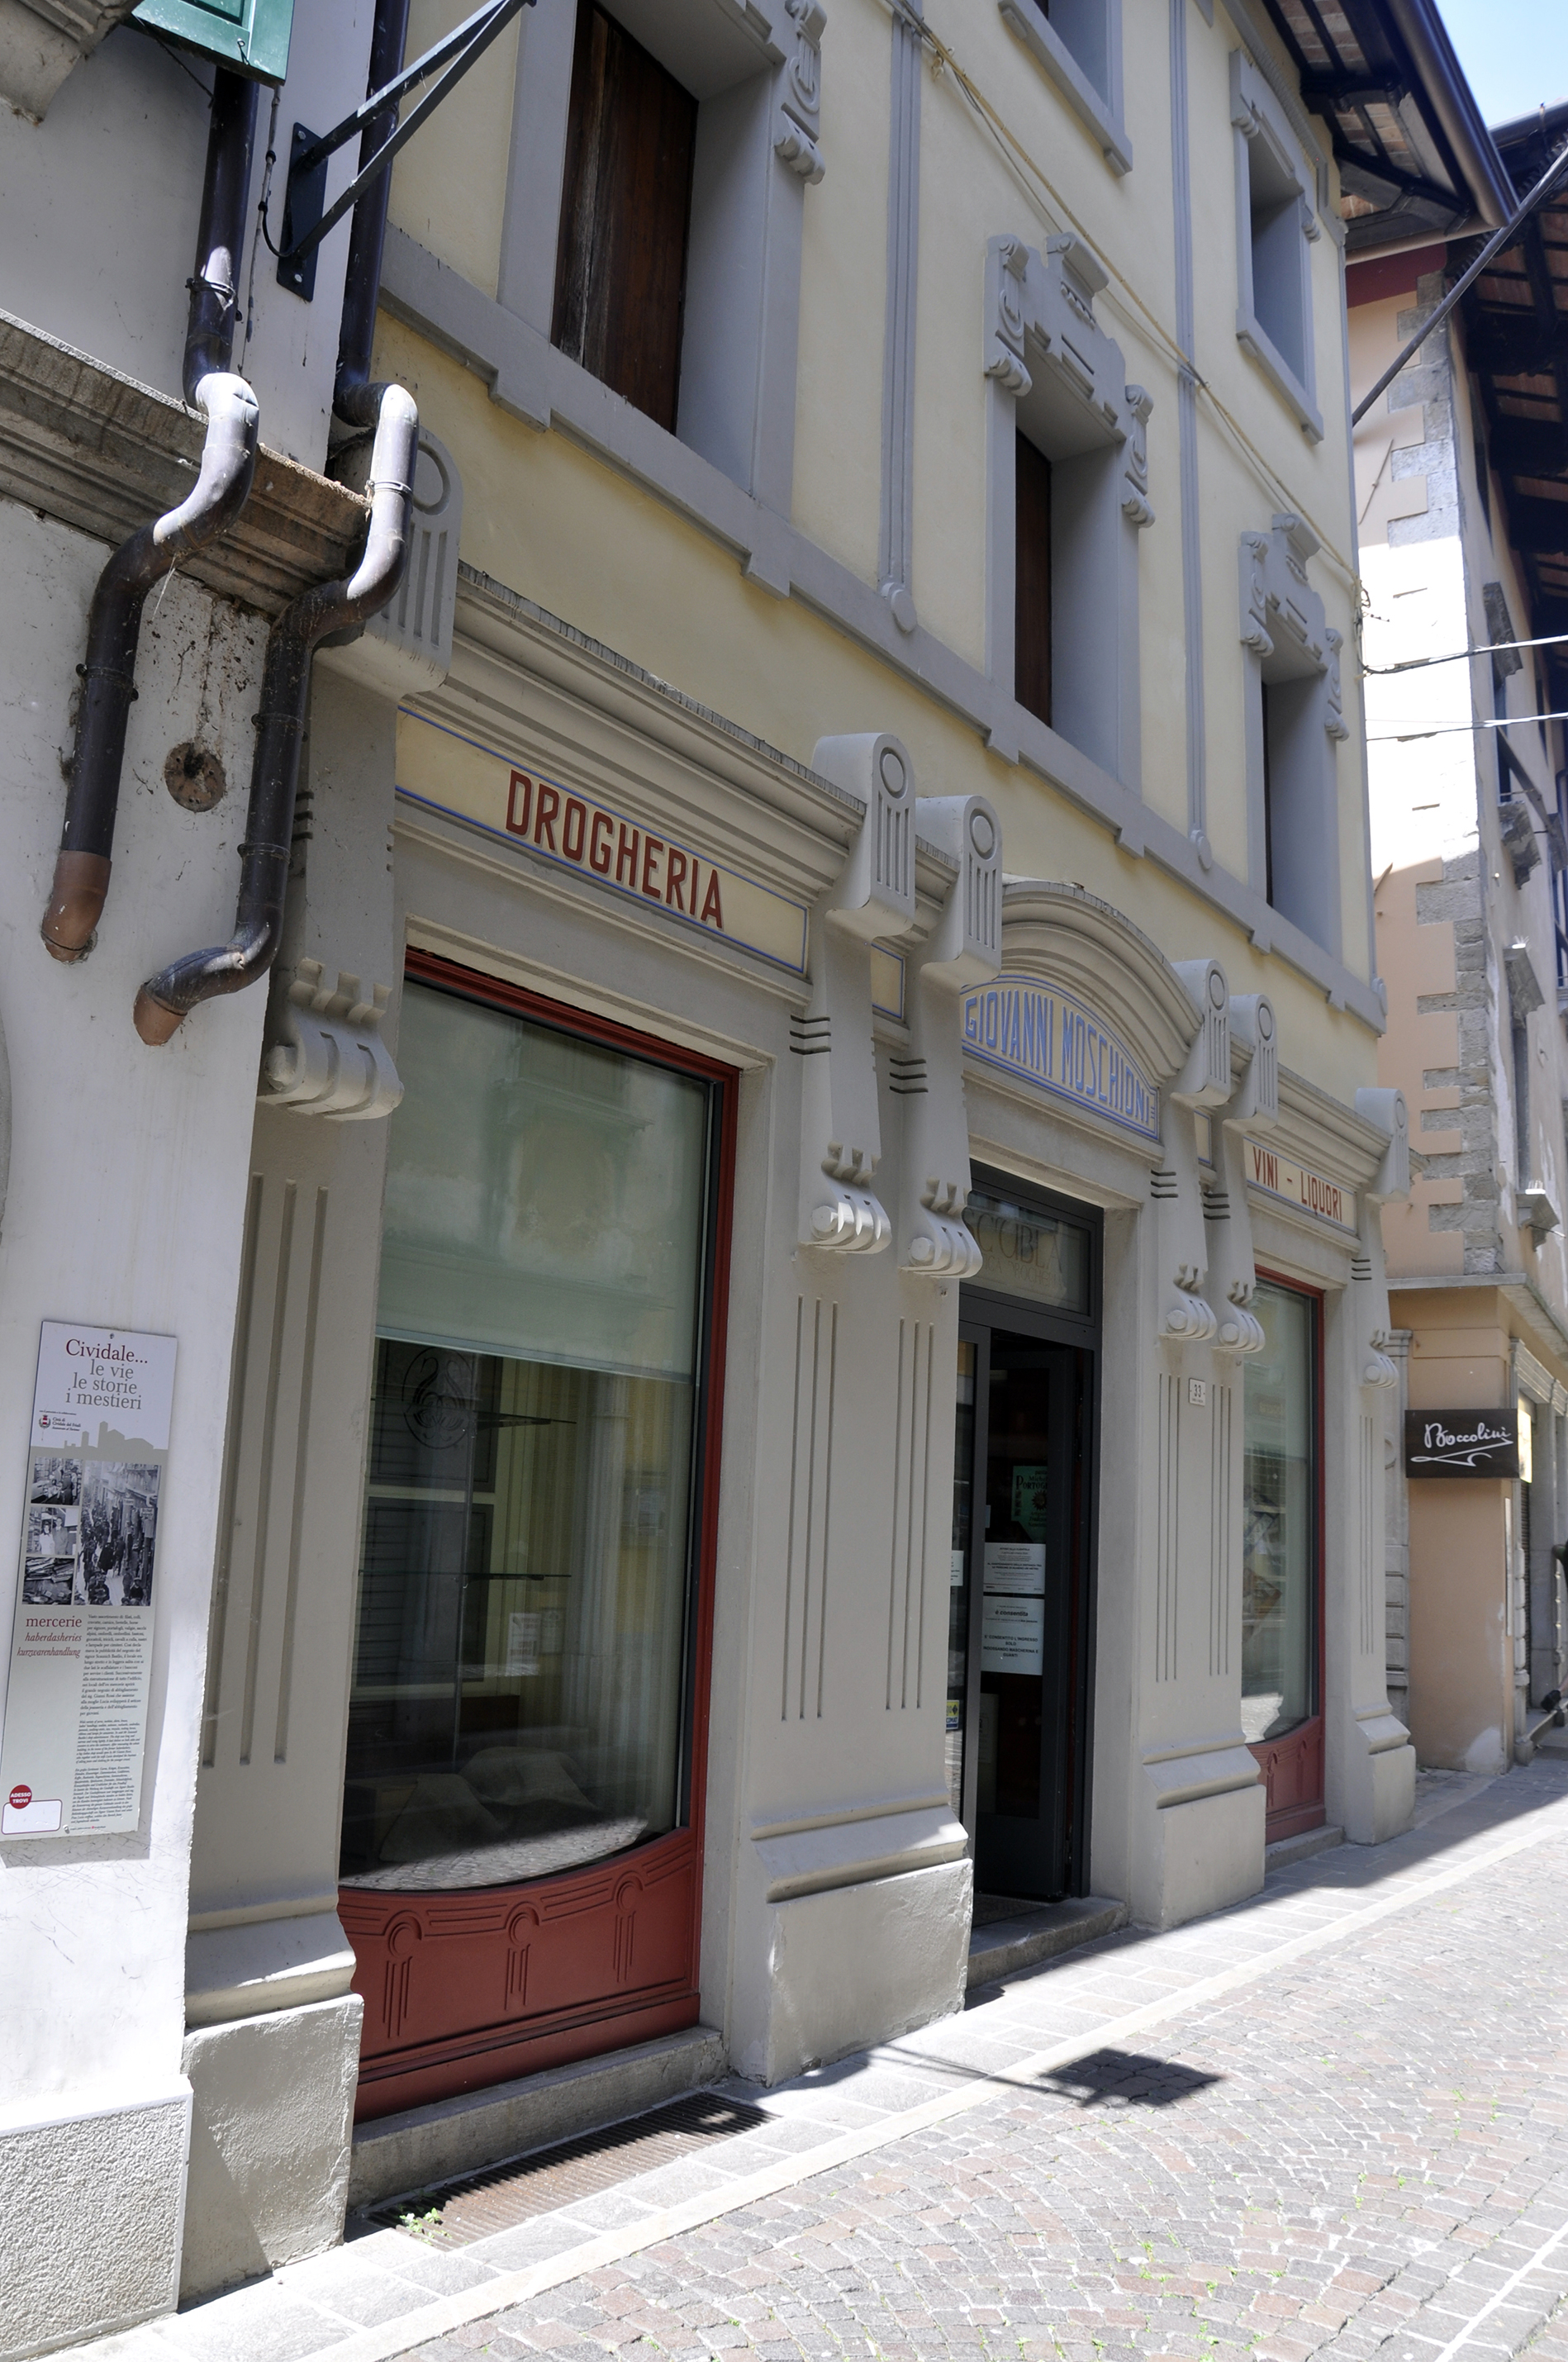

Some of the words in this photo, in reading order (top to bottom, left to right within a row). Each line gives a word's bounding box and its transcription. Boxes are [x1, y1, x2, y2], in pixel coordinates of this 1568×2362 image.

[506, 769, 723, 929] DROGHERIA
[965, 990, 1052, 1077] GIOVANNI
[1062, 1005, 1149, 1123] MOSCHIONI
[1253, 1146, 1278, 1191] VINI
[1300, 1171, 1342, 1222] LIQUORI
[66, 1338, 148, 1364] Cividale...
[90, 1359, 104, 1376] le
[111, 1364, 134, 1379] vie
[73, 1372, 87, 1390] le
[93, 1377, 137, 1395] storie
[65, 1388, 71, 1404] i
[77, 1392, 142, 1409] mestieri
[1424, 1422, 1512, 1448] Boccolini
[26, 1615, 82, 1628] mercerie
[25, 1632, 82, 1642] haberdasheries
